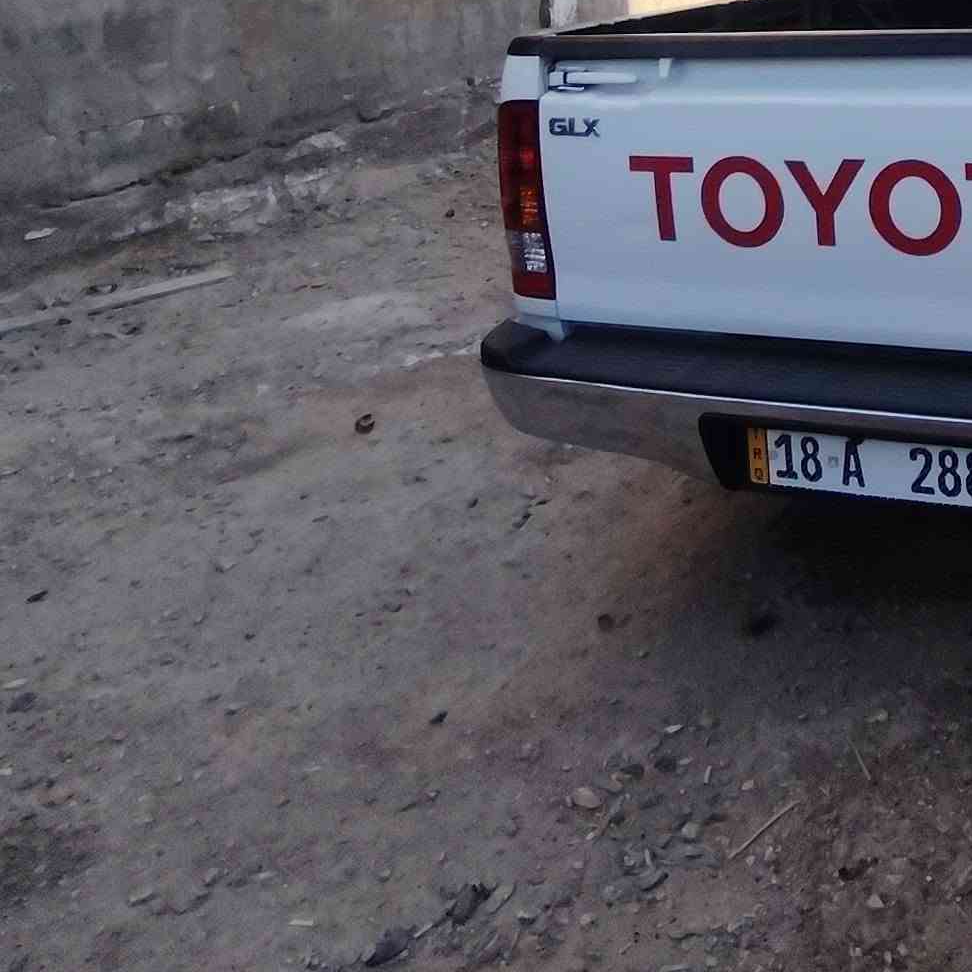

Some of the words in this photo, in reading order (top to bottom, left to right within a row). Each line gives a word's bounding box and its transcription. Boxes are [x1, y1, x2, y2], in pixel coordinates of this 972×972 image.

[549, 117, 601, 137] GLX
[774, 433, 824, 483] 18
[842, 436, 867, 488] A
